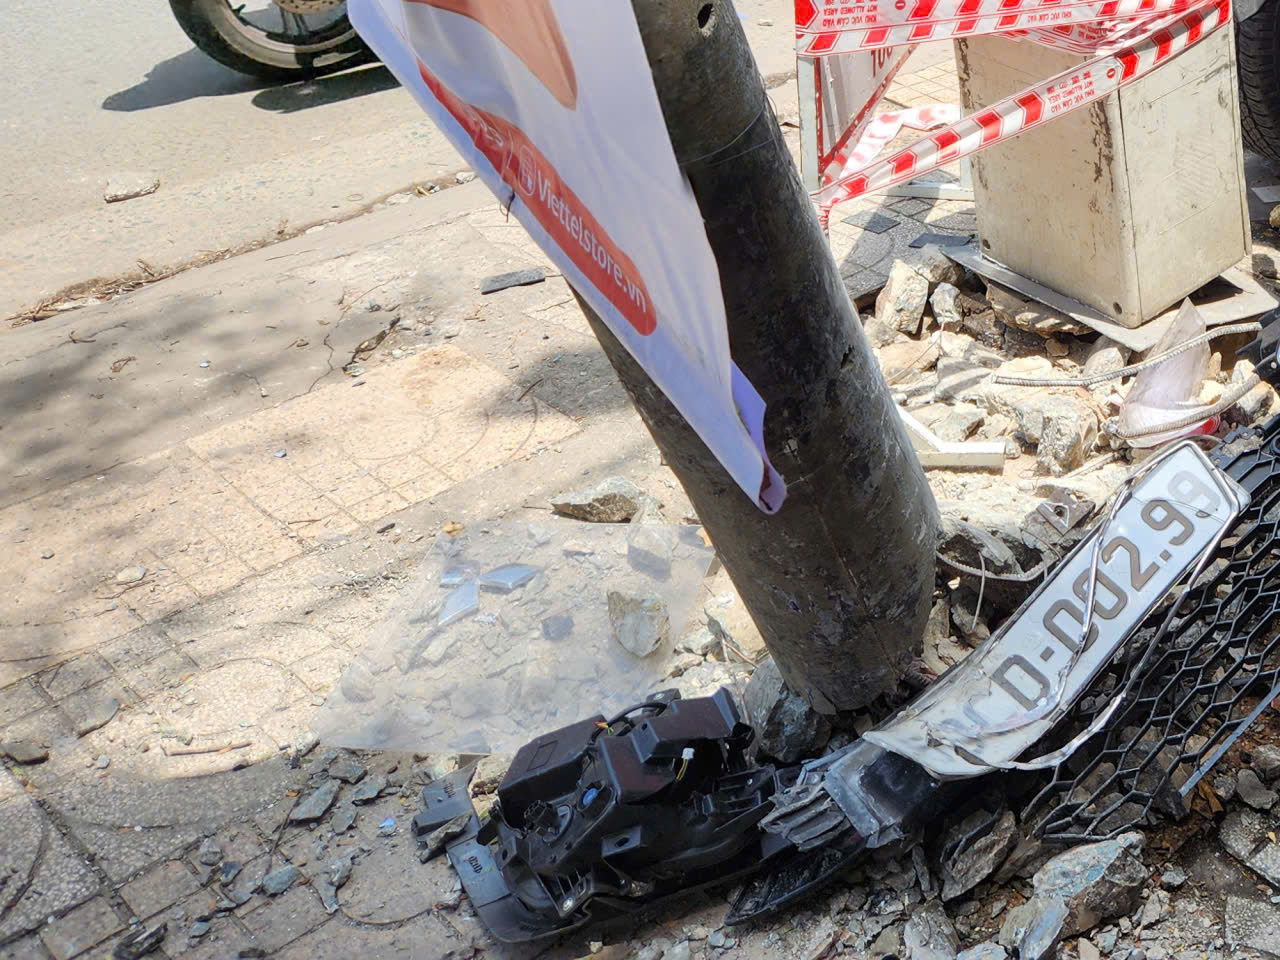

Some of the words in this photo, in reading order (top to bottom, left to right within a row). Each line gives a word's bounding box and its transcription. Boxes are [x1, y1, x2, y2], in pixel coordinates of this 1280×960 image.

[823, 7, 839, 16] AREA
[840, 5, 865, 15] ALLOWED
[866, 5, 878, 13] NOT
[536, 169, 648, 313] Viettelstore.vn
